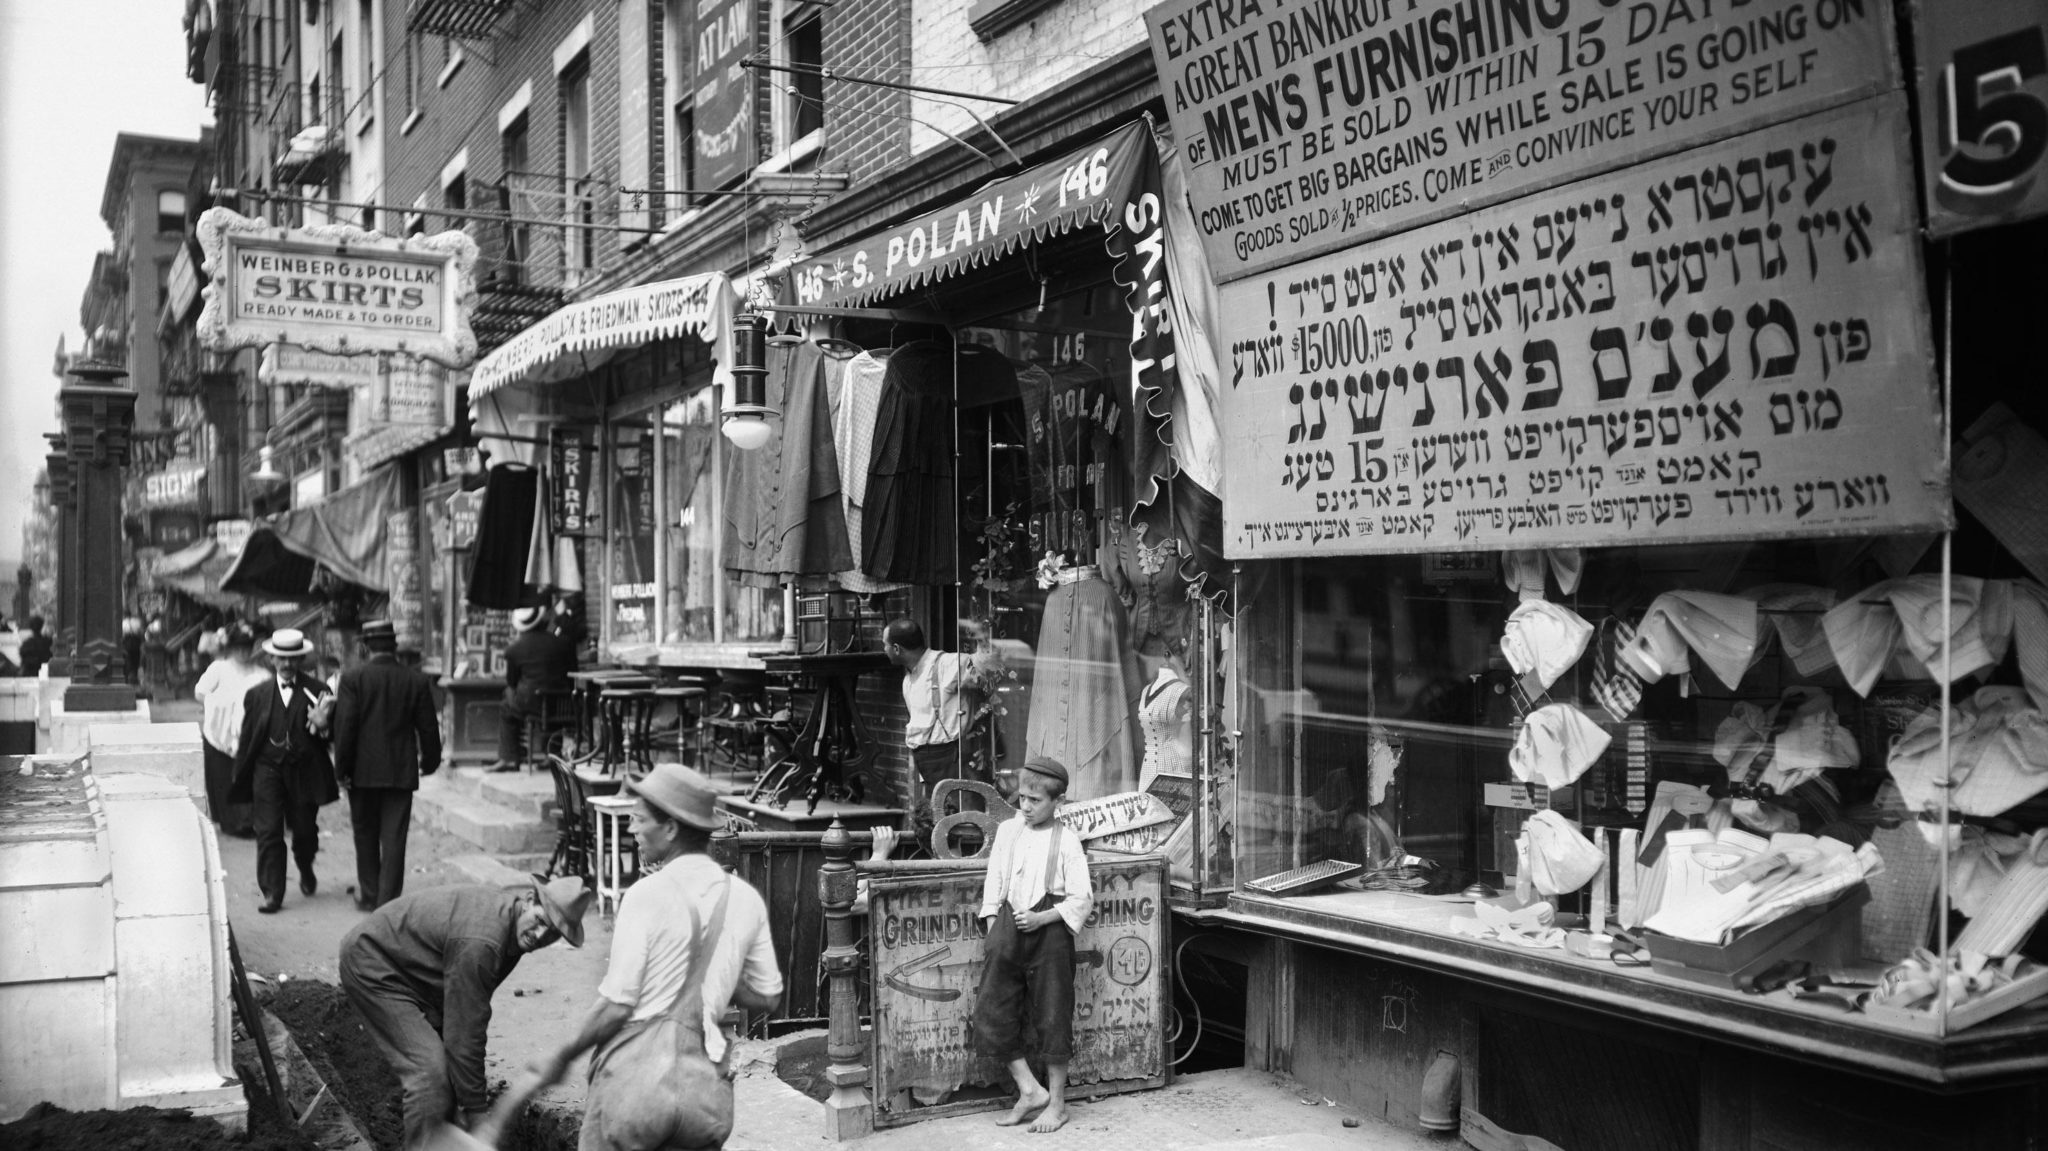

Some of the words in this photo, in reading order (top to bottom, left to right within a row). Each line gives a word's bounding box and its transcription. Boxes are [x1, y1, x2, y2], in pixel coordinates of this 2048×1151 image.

[1160, 0, 1264, 61] EXTRA
[1174, 80, 1189, 114] A
[1185, 30, 1263, 105] GREAT
[1267, 0, 1418, 69] BANKRU
[1188, 138, 1206, 164] OF
[1203, 73, 1308, 162] MEN'S
[1201, 199, 1244, 236] COME
[1242, 191, 1264, 221] TO
[1265, 180, 1294, 214] GET
[1299, 168, 1330, 203] BIG
[1334, 127, 1448, 190] BARGAINS
[1456, 91, 1550, 147] WHILE
[1561, 58, 1644, 114] SALE
[1656, 44, 1687, 84] IS
[1697, 4, 1807, 70] GOING
[1816, 0, 1865, 30] ON
[1223, 141, 1293, 191] MUST
[1302, 123, 1336, 162] BE
[1344, 96, 1412, 146] SOLD
[1425, 43, 1539, 116] WITHIN
[1556, 17, 1606, 77] 15
[1234, 223, 1285, 261] GOODS
[1289, 208, 1329, 243] SOLD
[1355, 180, 1419, 219] PRICES.
[1424, 158, 1483, 202] COME
[1488, 154, 1511, 176] AND
[1516, 107, 1635, 168] CONVINCE
[1644, 83, 1718, 131] YOUR
[1731, 49, 1818, 105] SELF
[1648, 136, 1837, 233] עקסטרא
[797, 265, 824, 305] 146
[852, 250, 874, 289] S.
[886, 195, 1004, 277] POLAN
[1059, 147, 1109, 208] 146
[1533, 193, 1629, 265] נייעס
[1798, 202, 1873, 283] אין
[241, 254, 350, 278] WEINBERG
[354, 267, 364, 279] &
[1421, 239, 1464, 290] דיא
[1471, 222, 1519, 288] אין
[1632, 221, 1788, 308] גרויסער
[253, 275, 425, 310] SKIRTS
[648, 288, 683, 322] SKIRTS
[1344, 254, 1405, 307] איסט
[244, 302, 297, 317] READY
[303, 307, 343, 321] MADE
[347, 311, 356, 321] &
[360, 310, 378, 323] TO
[1052, 331, 1085, 367] 146
[1813, 317, 1872, 382] פון
[1052, 388, 1121, 436] POLAN
[1287, 338, 1563, 444] פארנישינג
[1769, 388, 1843, 435] מוס
[1281, 449, 1335, 493] טעג
[1348, 436, 1389, 484] 15
[1529, 464, 1604, 497] קויפט
[1657, 448, 1762, 486] קאמט
[564, 448, 581, 530] SKIRTS
[1423, 473, 1508, 509] גרויסע
[1590, 491, 1693, 530] פערקויפט
[1794, 473, 1890, 519] ווארע
[680, 506, 695, 528] 144
[1382, 513, 1435, 540] קאמט
[882, 910, 989, 949] GRINDIN
